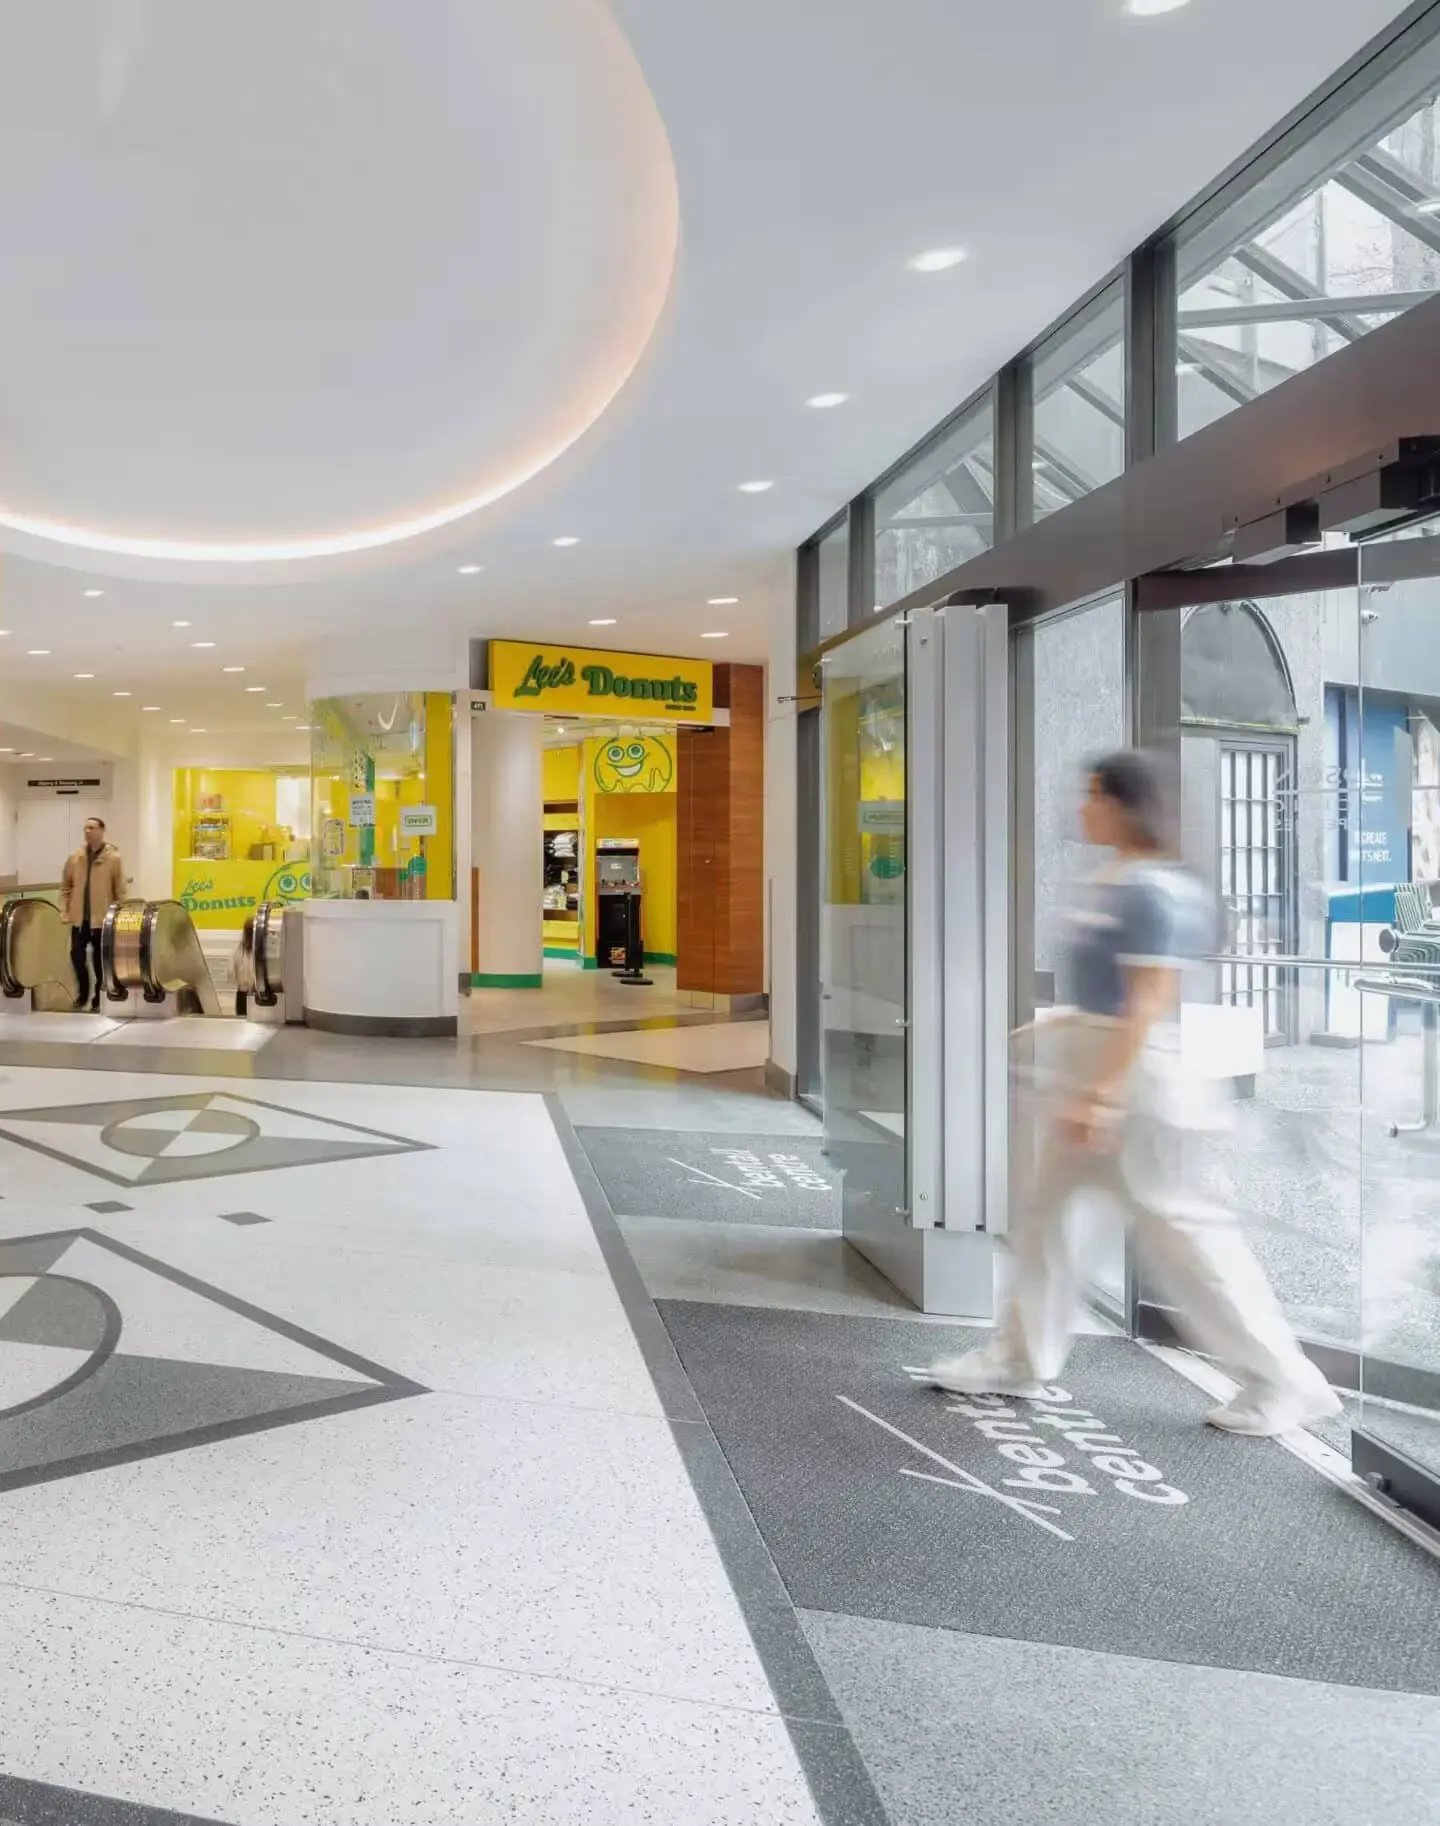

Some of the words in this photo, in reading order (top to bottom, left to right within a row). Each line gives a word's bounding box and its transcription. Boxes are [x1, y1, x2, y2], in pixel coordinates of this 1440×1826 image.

[513, 655, 576, 698] Lee's
[581, 665, 697, 703] Donuts
[182, 893, 256, 912] Donuts
[902, 1365, 1098, 1496] bent
